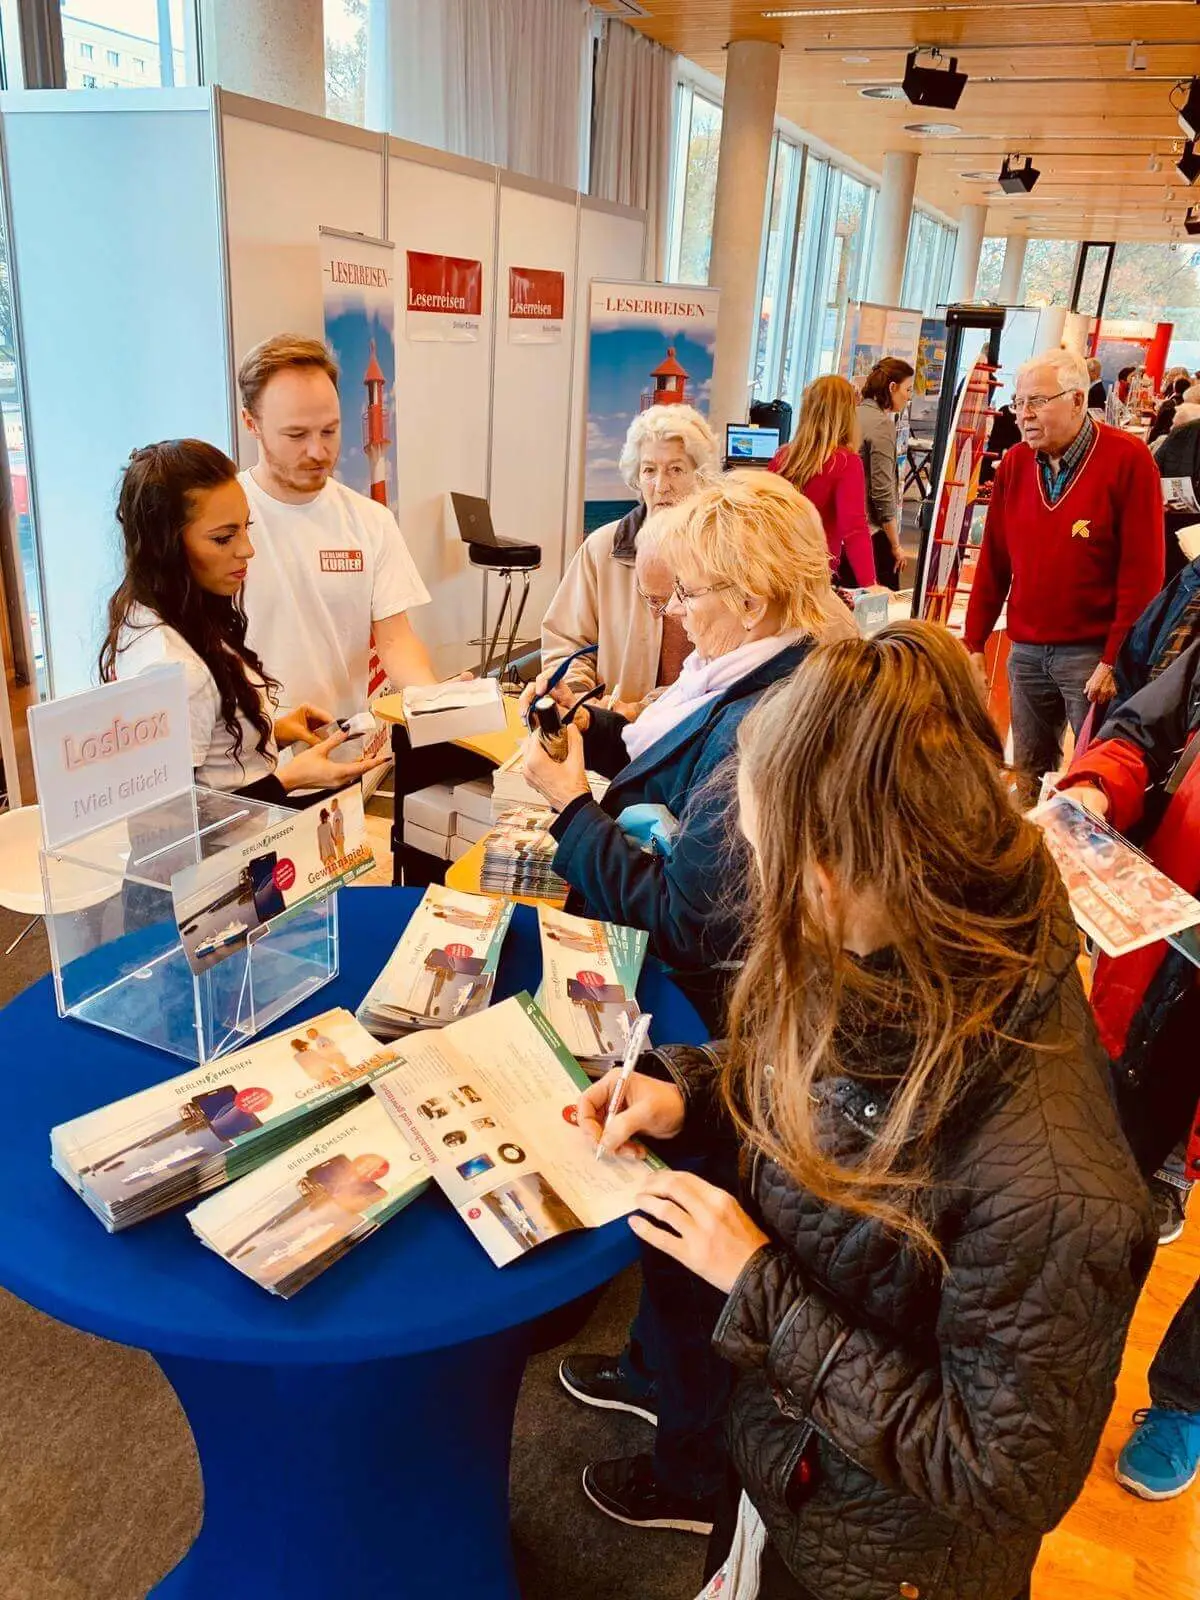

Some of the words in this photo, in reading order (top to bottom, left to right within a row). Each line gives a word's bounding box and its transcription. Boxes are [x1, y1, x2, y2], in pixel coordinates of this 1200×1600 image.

[330, 260, 389, 288] LESERREISEN
[408, 287, 466, 310] Leserreisen
[510, 298, 552, 315] Leserreisen
[606, 297, 706, 317] LESERREISEN
[322, 559, 362, 571] KURIER
[63, 711, 167, 771] Losbox
[118, 764, 169, 800] Glück!
[241, 839, 264, 857] BERLIN
[270, 824, 295, 842] MESSEN
[307, 844, 365, 885] Gewinnspiel
[174, 1077, 208, 1096] BERLIN
[217, 1058, 253, 1081] MESSEN
[294, 1053, 384, 1101] Gewinnspiel
[286, 1149, 317, 1171] BERLIN
[324, 1124, 360, 1150] MESSEN
